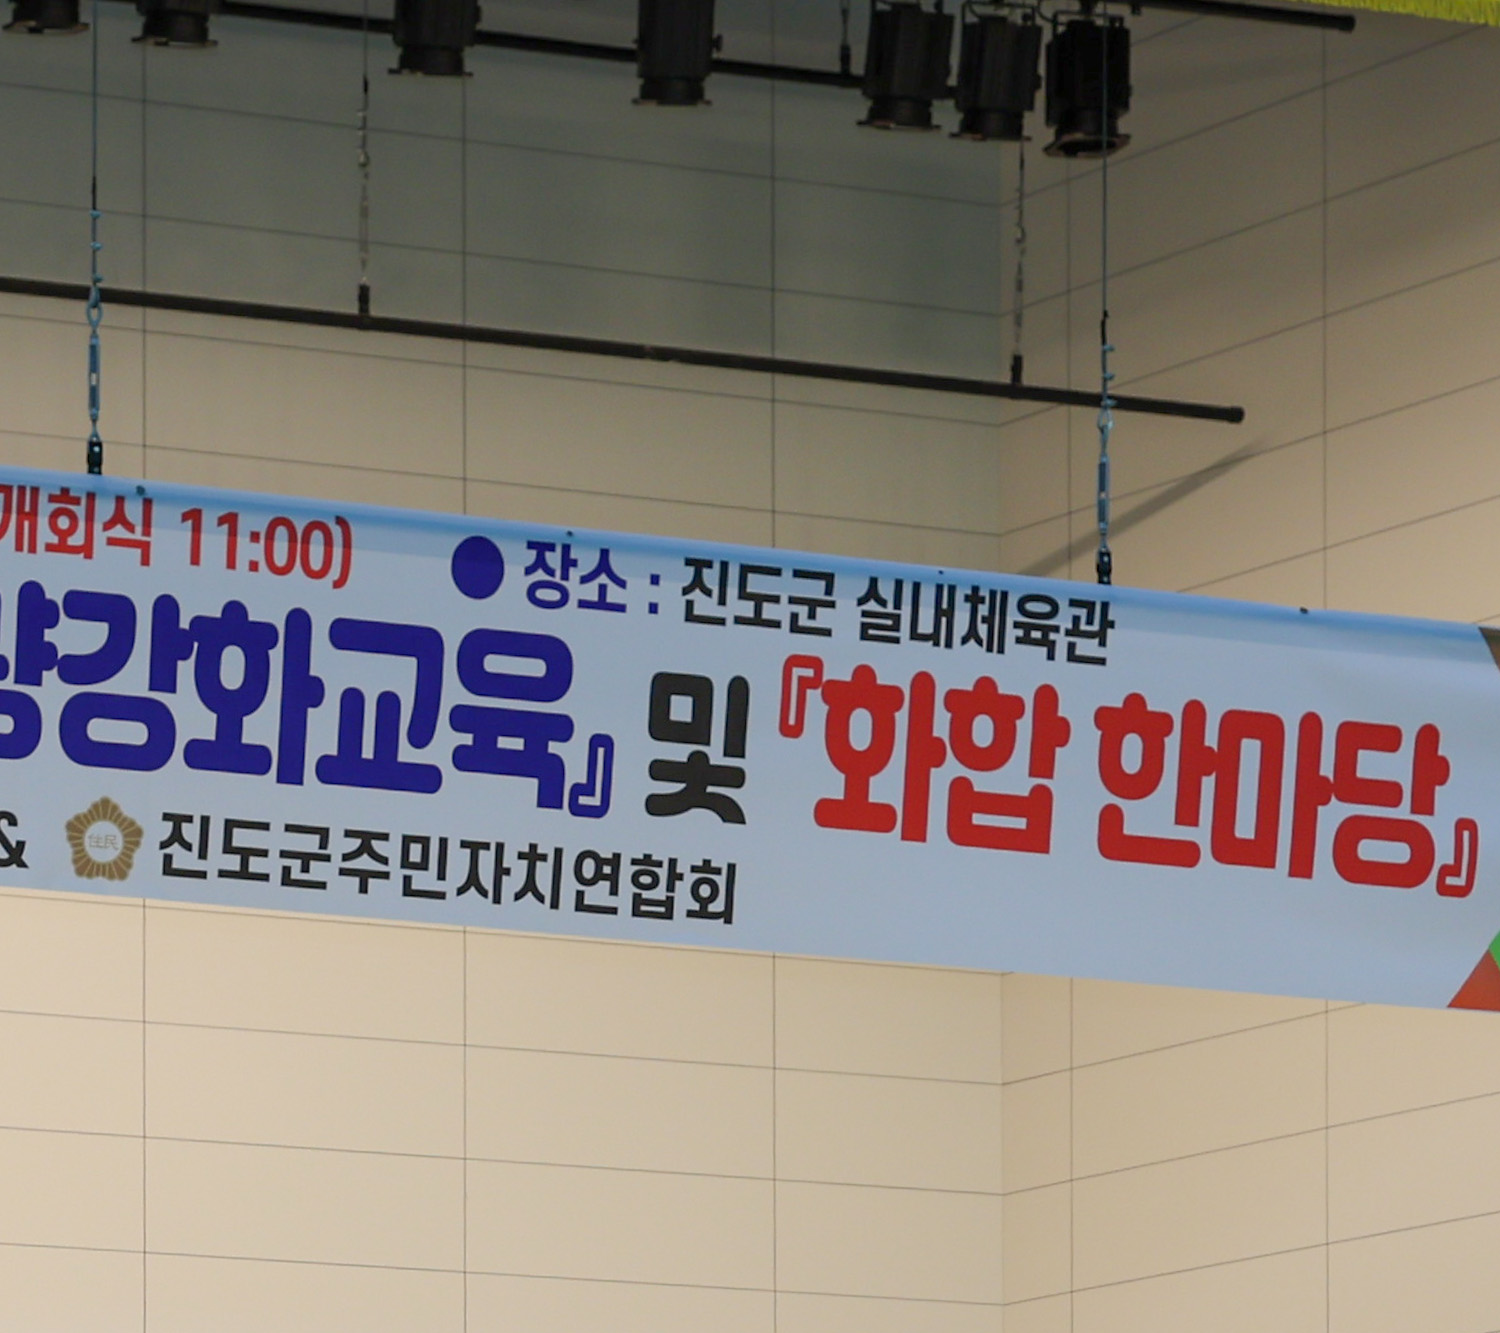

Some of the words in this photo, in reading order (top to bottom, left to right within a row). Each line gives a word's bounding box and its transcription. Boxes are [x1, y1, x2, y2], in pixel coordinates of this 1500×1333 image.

[179, 506, 354, 590] 11:00)
[523, 539, 628, 614] 장소
[680, 556, 836, 637] 진도군
[856, 576, 1115, 667] 실내체육관
[644, 671, 750, 825] 및
[779, 653, 1072, 855] 『화합
[1093, 692, 1479, 898] 한마당』
[157, 810, 737, 925] 진도군주민자치연합회
